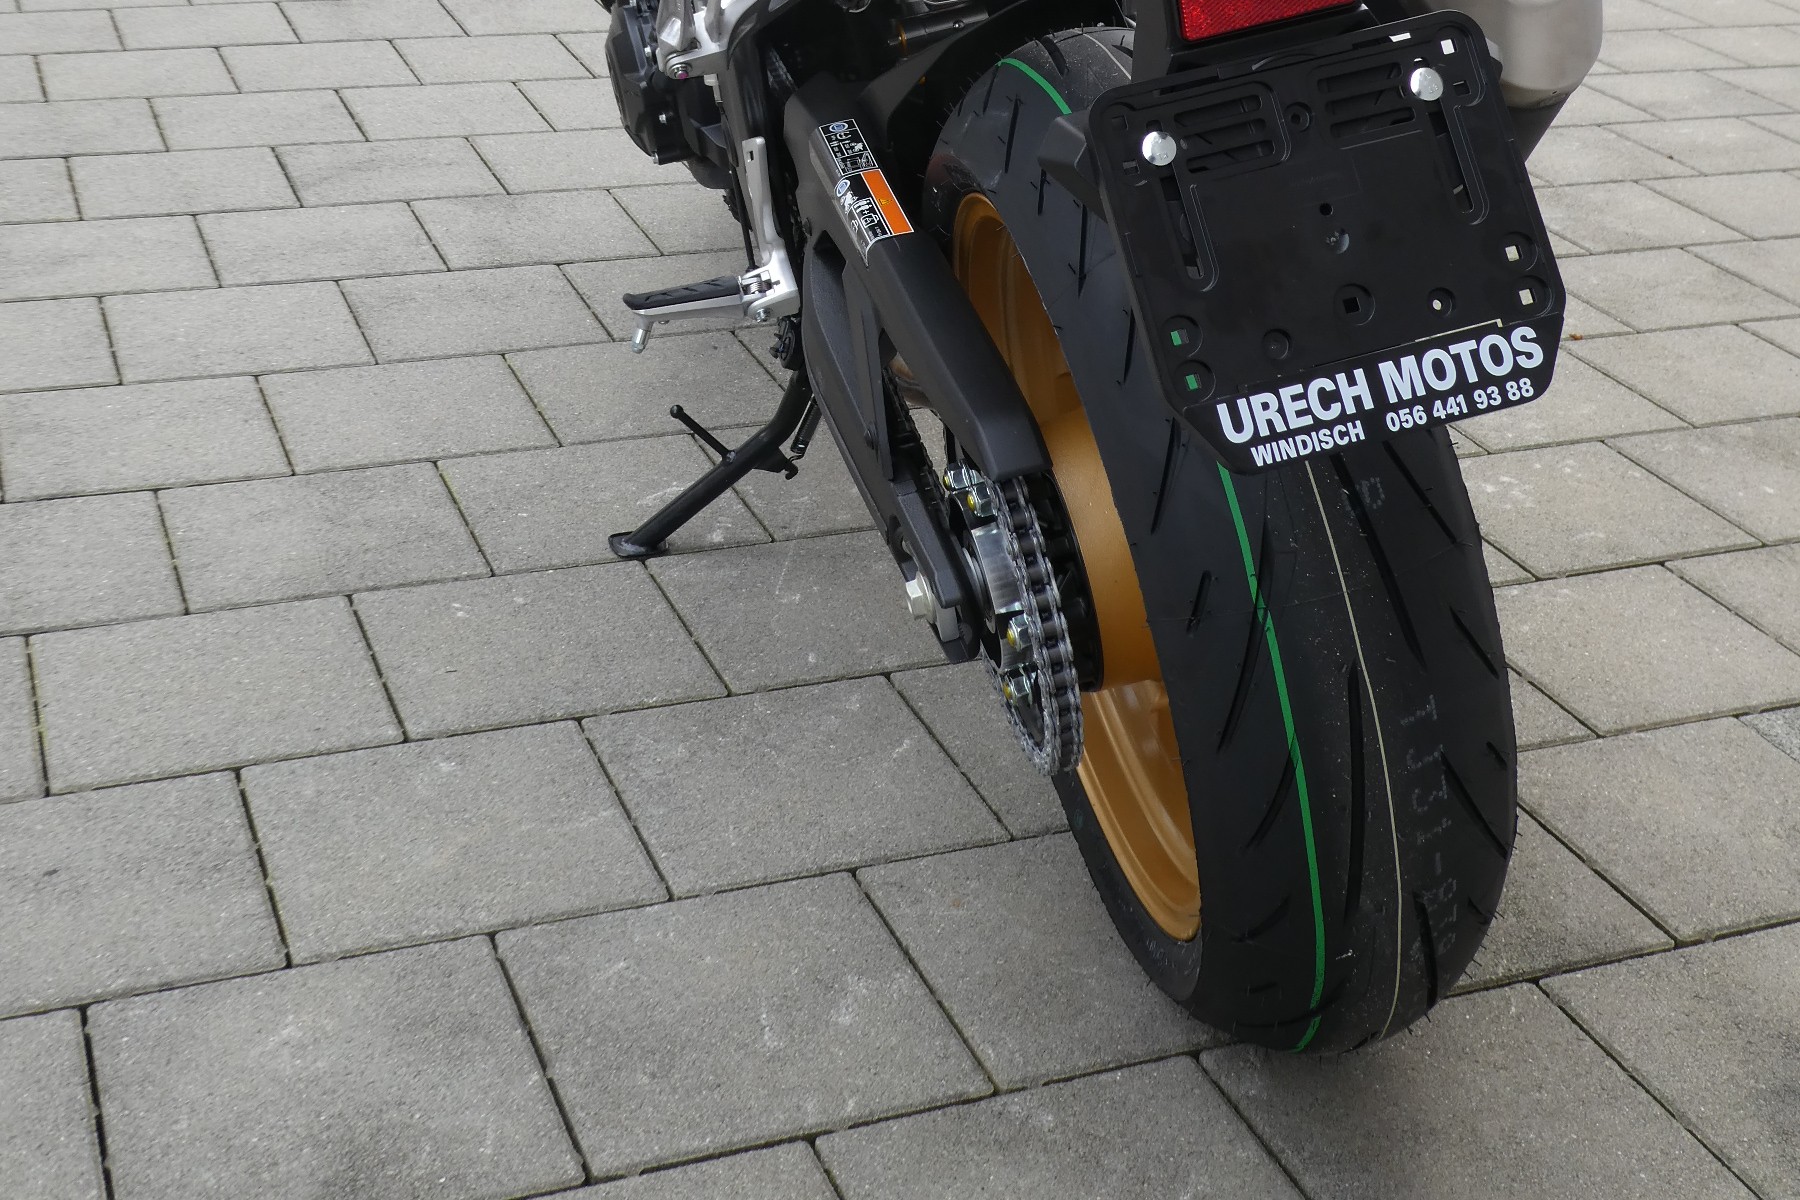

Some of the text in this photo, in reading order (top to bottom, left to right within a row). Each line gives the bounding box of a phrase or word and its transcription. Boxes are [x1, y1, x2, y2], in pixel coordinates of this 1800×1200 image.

[1217, 327, 1543, 443] URECH MOTOS
[1251, 378, 1533, 466] WINDISCH 056 441 93 88
